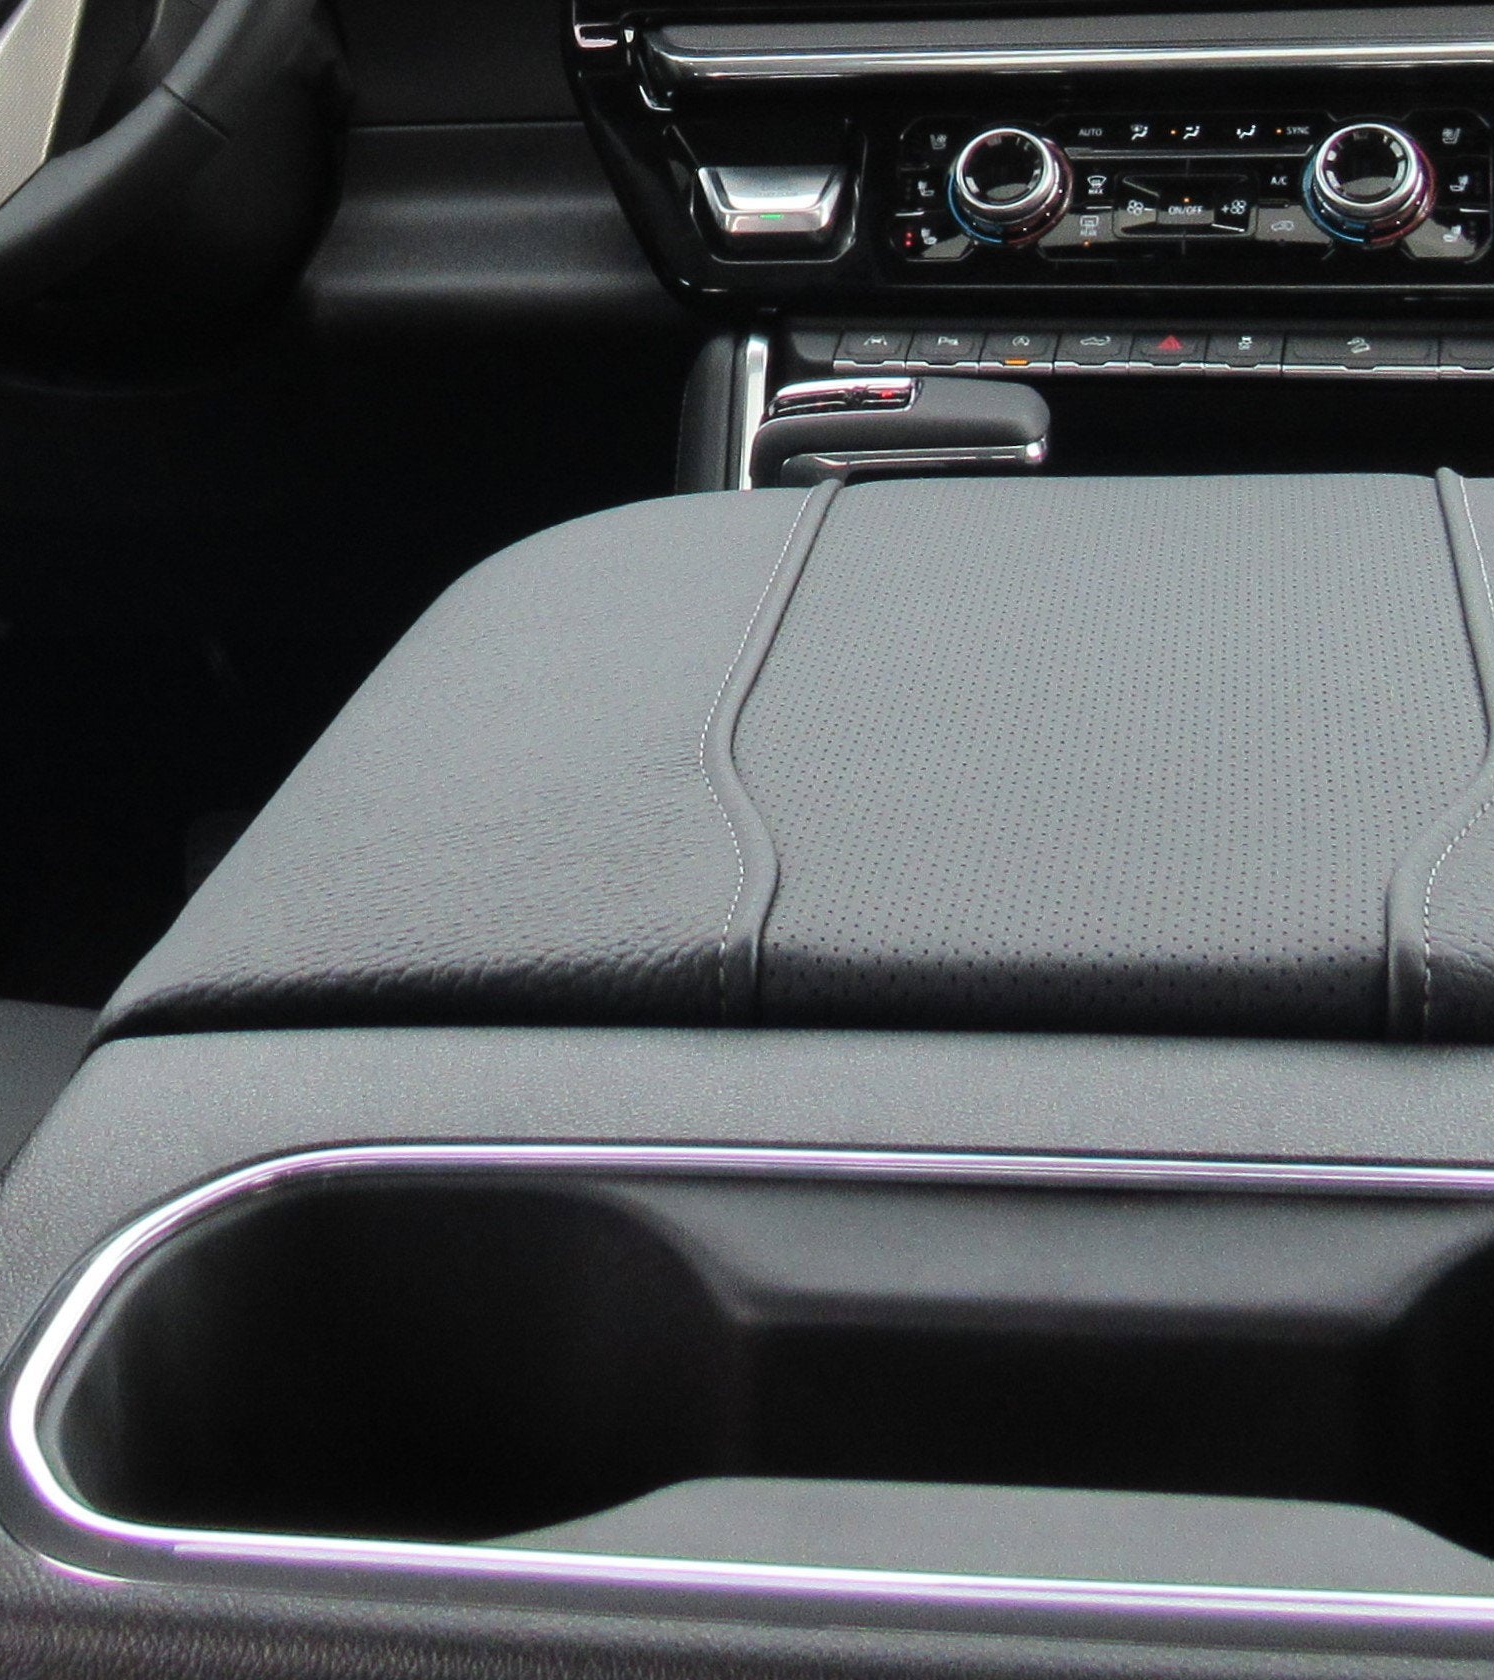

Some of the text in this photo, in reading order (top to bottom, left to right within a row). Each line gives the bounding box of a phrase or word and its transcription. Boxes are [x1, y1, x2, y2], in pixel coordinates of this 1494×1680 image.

[1078, 128, 1103, 137] AUTO
[1286, 126, 1310, 135] SYNC
[1270, 176, 1288, 186] A/C
[1167, 205, 1204, 216] ON/OFF
